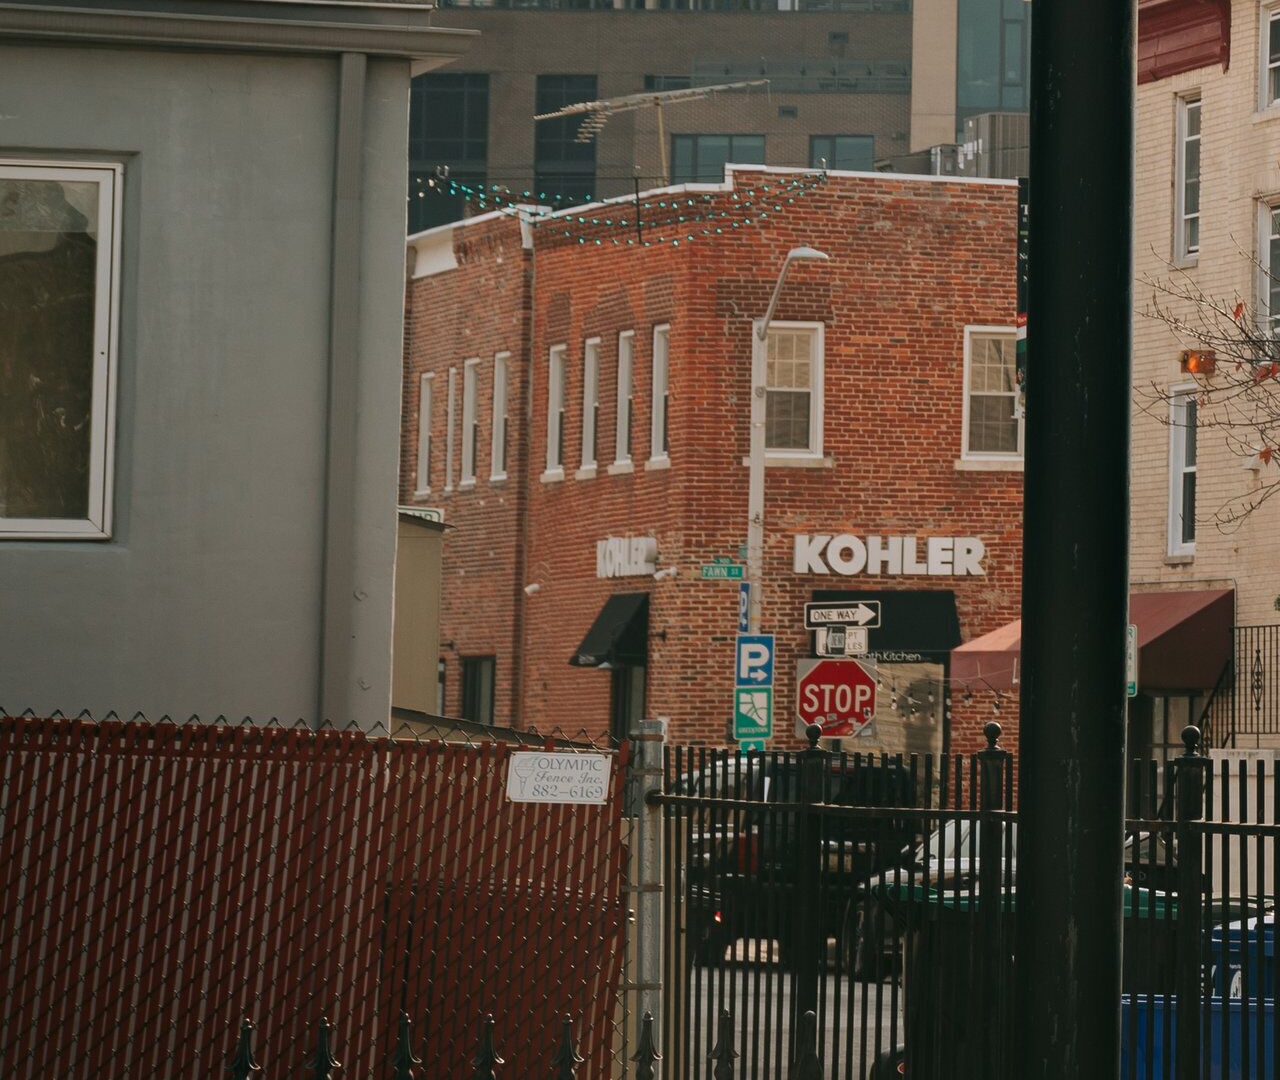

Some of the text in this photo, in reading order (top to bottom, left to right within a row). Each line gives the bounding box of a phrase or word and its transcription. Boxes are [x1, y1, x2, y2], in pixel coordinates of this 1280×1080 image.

[794, 533, 987, 576] KOHLER
[703, 567, 727, 577] FAWN
[813, 609, 858, 621] ONE WAY
[883, 652, 921, 661] Kitchen
[803, 683, 872, 713] STOP
[538, 757, 603, 772] OLYMPIC
[535, 771, 603, 784] Fence Inc.
[532, 784, 603, 798] 882-6169
